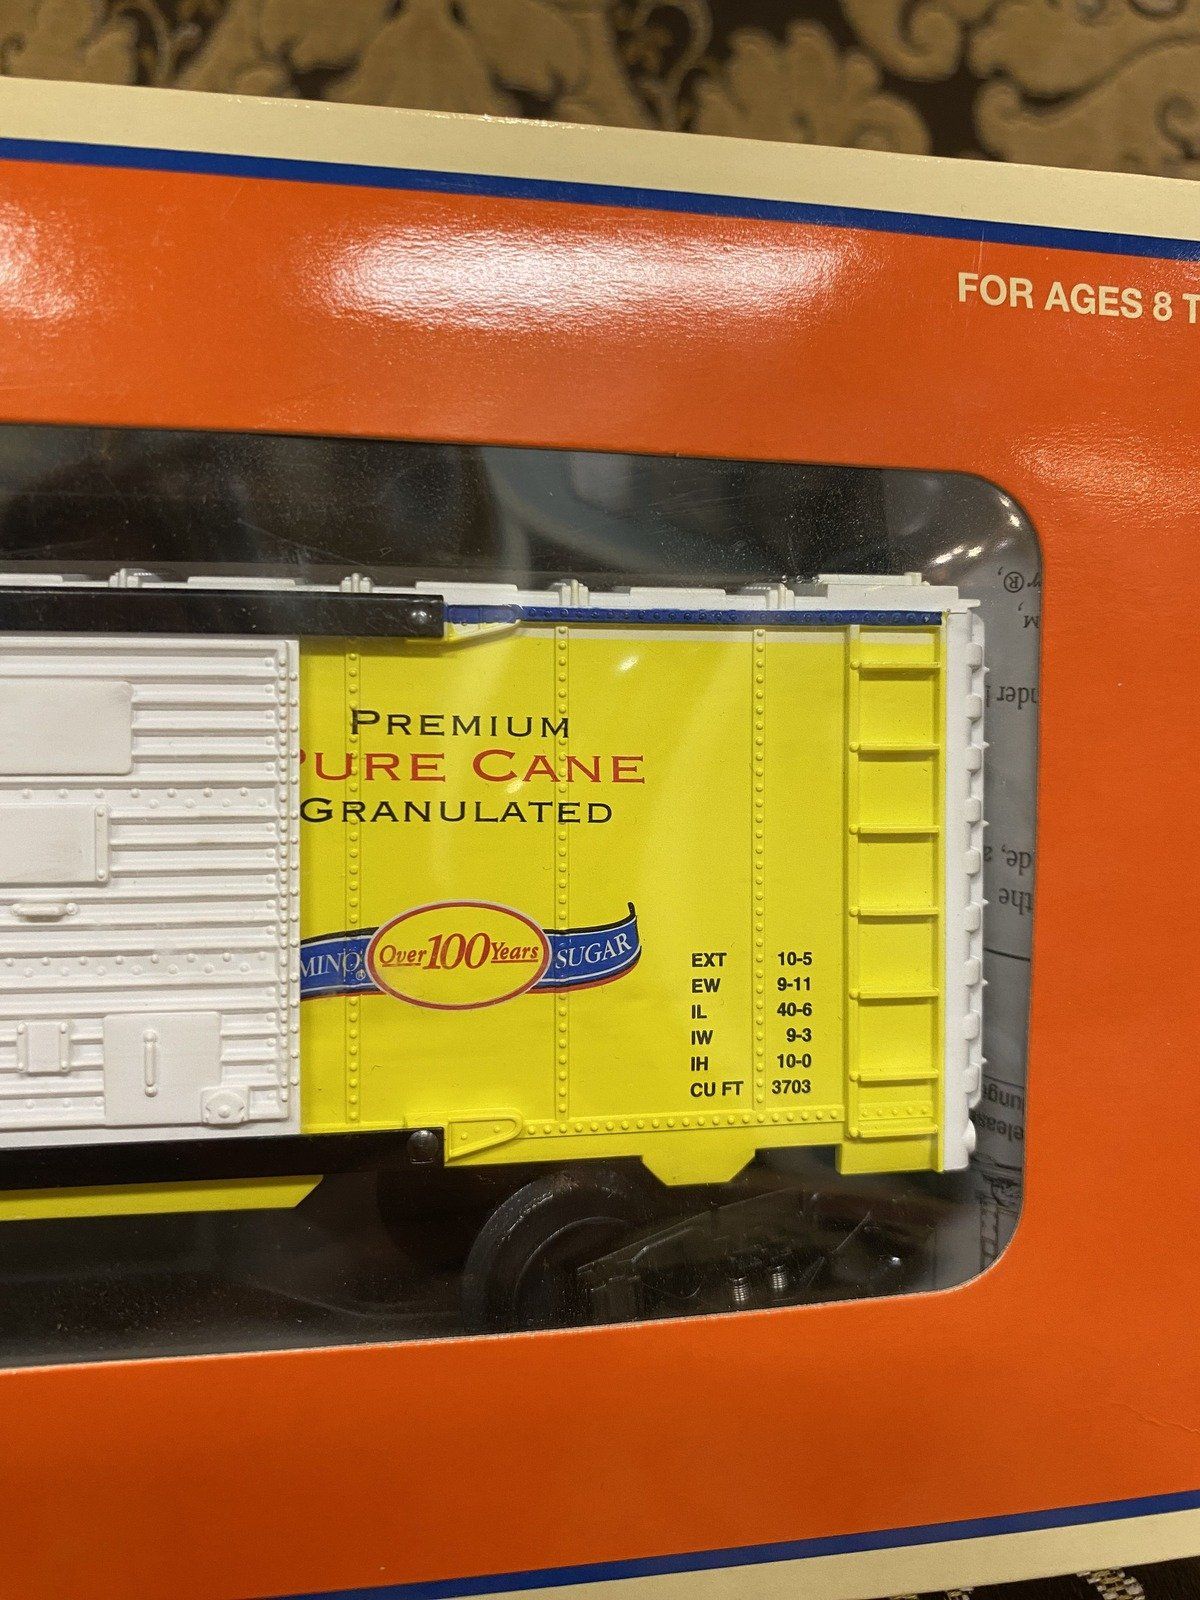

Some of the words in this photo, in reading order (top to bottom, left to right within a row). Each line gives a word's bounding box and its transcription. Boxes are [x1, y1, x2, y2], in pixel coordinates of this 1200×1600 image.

[958, 272, 1034, 309] FOR
[1044, 281, 1144, 319] AGES
[1152, 291, 1173, 322] 8
[350, 709, 570, 739] PREMIUM
[300, 748, 446, 783] URE
[472, 748, 646, 784] CANE
[299, 797, 613, 824] GRANULATED
[379, 943, 427, 967] Over
[422, 932, 493, 970] 100
[490, 941, 540, 963] Years
[555, 931, 633, 970] SUGAR
[691, 952, 727, 968] EXT
[777, 951, 813, 966] 10-5
[691, 978, 721, 993] EW
[777, 977, 811, 991] 9-11
[691, 1004, 707, 1019] IL
[776, 1002, 813, 1017] 40-6
[691, 1030, 713, 1045] IW
[786, 1027, 812, 1042] 9-3
[690, 1056, 709, 1071] IH
[777, 1053, 812, 1068] 10-0
[690, 1082, 716, 1097] CU
[721, 1081, 744, 1096] FT
[771, 1079, 811, 1094] 3703
